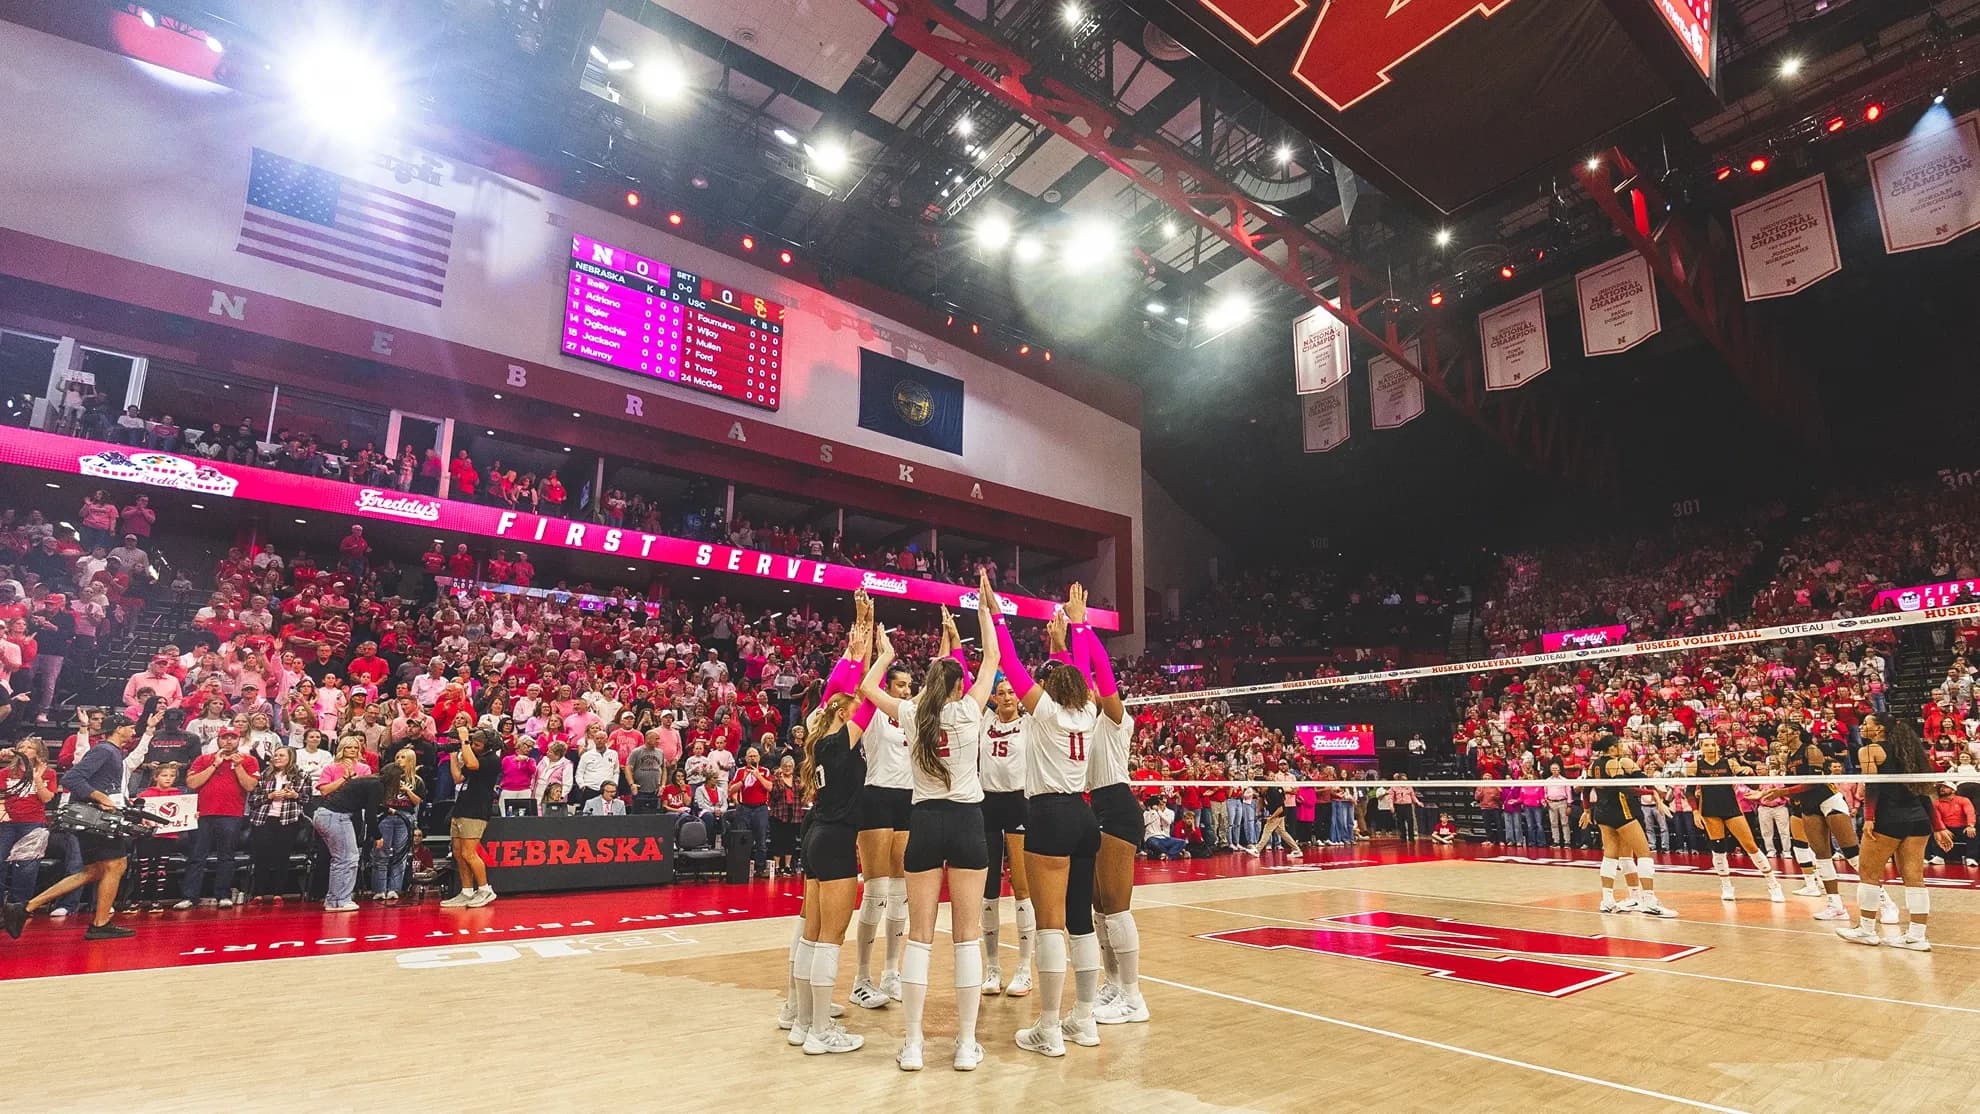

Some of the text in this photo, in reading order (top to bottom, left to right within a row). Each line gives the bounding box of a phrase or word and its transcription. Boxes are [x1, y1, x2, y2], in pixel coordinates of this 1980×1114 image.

[1891, 160, 1972, 197] CHAMPION
[1892, 155, 1968, 189] NATIONAL
[1750, 220, 1818, 250] CHAMPION
[1752, 214, 1814, 242] NATIONAL
[1935, 224, 1948, 235] N
[592, 243, 648, 275] N 0
[576, 261, 625, 284] NEBRASKA
[647, 284, 654, 293] K
[673, 293, 680, 301] D
[677, 271, 691, 281] SET
[1786, 276, 1796, 287] N
[678, 283, 692, 293] 0-0
[722, 290, 733, 303] 0
[1591, 282, 1641, 304] NATIONAL
[586, 292, 621, 308] Adriano
[1590, 287, 1643, 311] CHAMPION
[688, 298, 706, 309] USC
[750, 318, 756, 326] K
[762, 322, 768, 330] B
[687, 323, 693, 331] 2
[1492, 322, 1534, 342] NATIONAL
[582, 332, 620, 349] Jackson
[696, 338, 722, 352] Mullen
[1490, 327, 1537, 349] CHAMPION
[1617, 336, 1626, 345] N
[581, 345, 613, 361] Murray
[695, 350, 713, 362] Ford
[681, 373, 692, 382] 24
[693, 377, 723, 391] McGee
[1376, 374, 1411, 392] CHAMPIO
[1513, 373, 1521, 381] N
[355, 489, 440, 521] Freddy's
[1672, 498, 1700, 518] 301
[497, 511, 827, 583] FIRST SERVE
[864, 572, 908, 593] Freddy's
[1283, 681, 1307, 689] HUSKER
[1307, 677, 1349, 686] VOLLEYBALL
[1431, 664, 1464, 673] HUSKER
[1465, 658, 1523, 670] VOLLEYBALL
[1535, 653, 1566, 662] DUTEAU
[1590, 647, 1620, 655] SUBARU
[1636, 639, 1680, 651] HUSKER
[1681, 630, 1761, 646] VOLLEYBALL
[1779, 623, 1824, 635] DUTEAU
[1859, 615, 1902, 625] SUBARU
[1925, 604, 1980, 618] HUSKE
[991, 741, 1008, 757] 15
[1068, 732, 1085, 761] 11
[1312, 735, 1359, 751] Freddy's
[476, 836, 663, 868] NEBRASKA
[179, 907, 749, 956] TERRY PETTIT COURT
